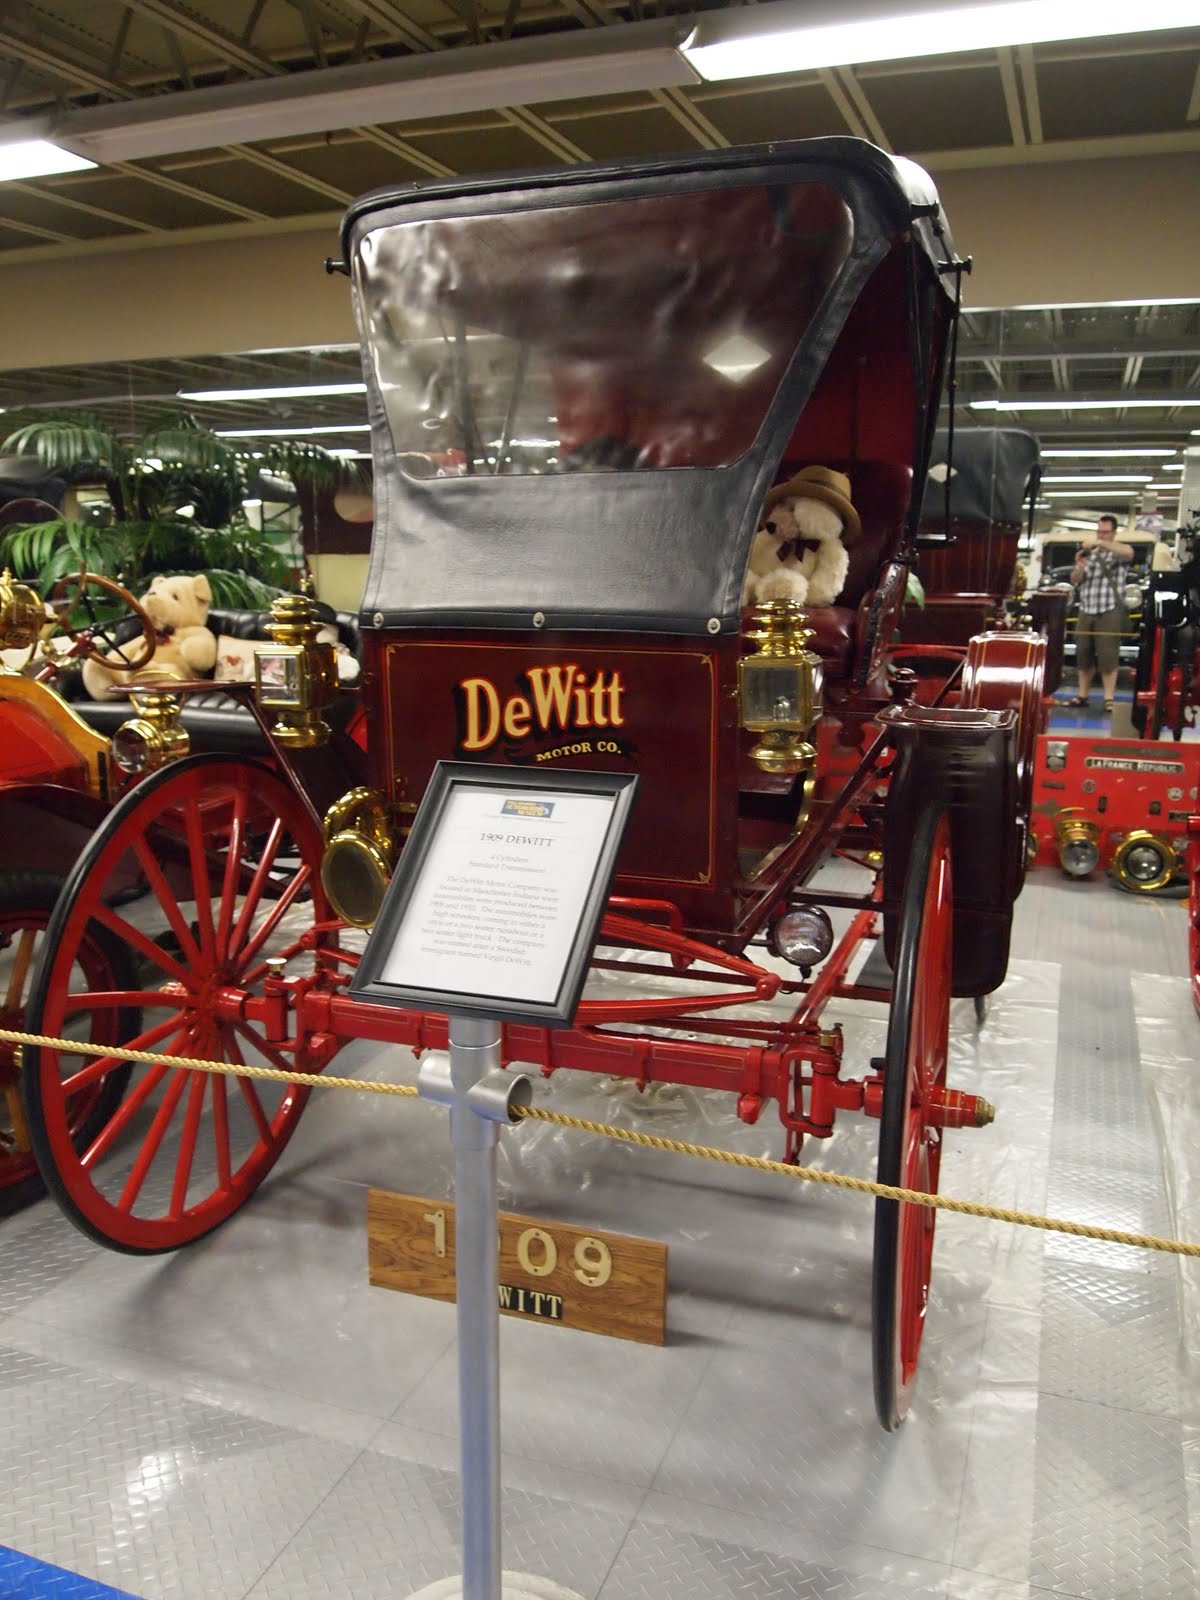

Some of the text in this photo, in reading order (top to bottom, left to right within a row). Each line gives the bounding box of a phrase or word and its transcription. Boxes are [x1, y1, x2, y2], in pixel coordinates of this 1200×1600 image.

[461, 665, 626, 750] DeWitt
[536, 741, 622, 761] MOTOR CO.
[480, 832, 555, 847] 1909 DEWITT
[424, 1210, 612, 1287] 109
[499, 1285, 562, 1319] WITT
